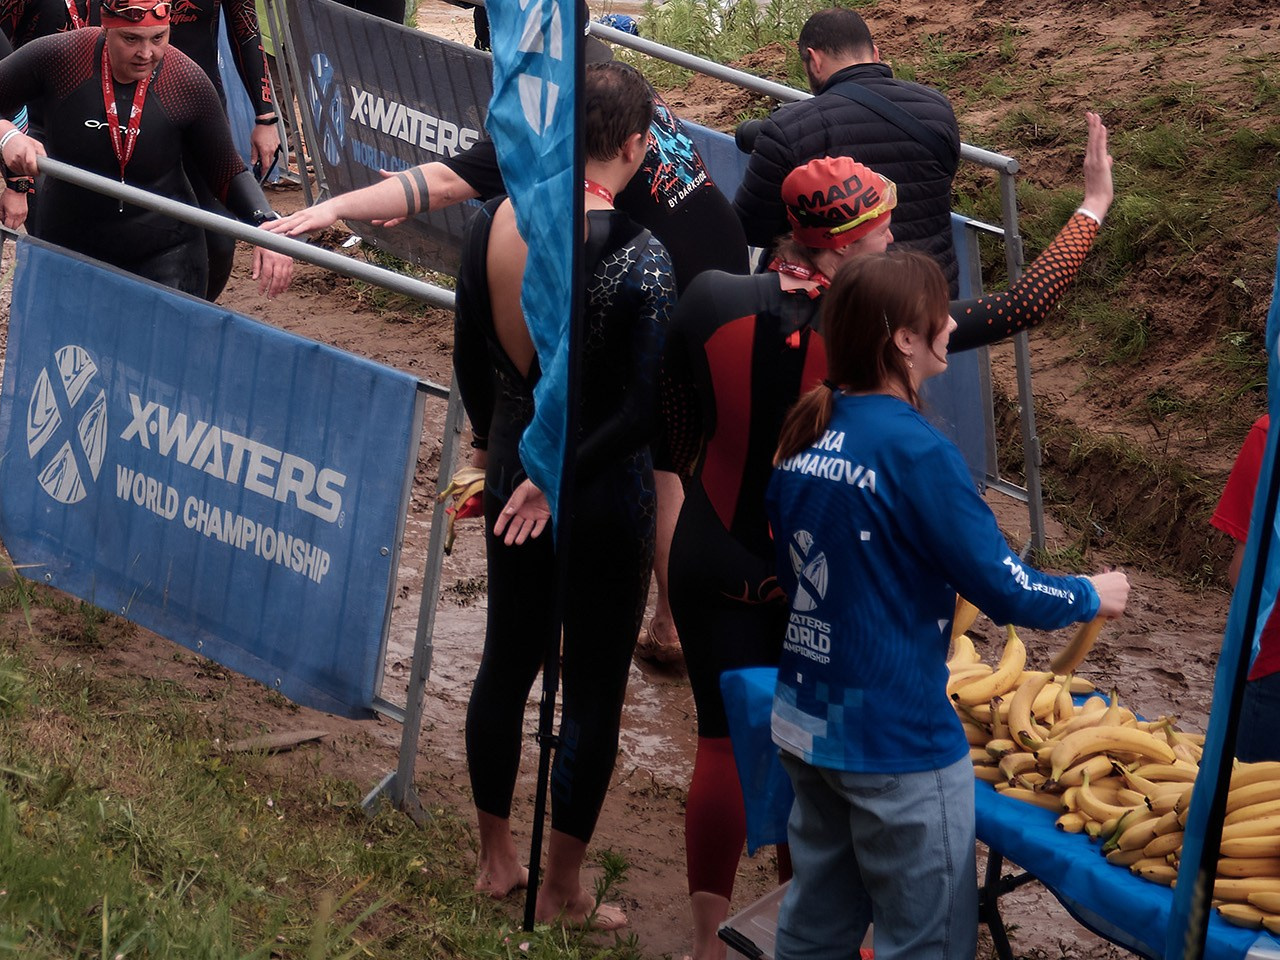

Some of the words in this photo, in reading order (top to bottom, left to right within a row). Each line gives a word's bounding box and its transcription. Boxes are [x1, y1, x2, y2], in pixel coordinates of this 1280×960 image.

[351, 138, 386, 172] WORLD
[667, 195, 678, 208] BY
[678, 171, 707, 200] DARKSIDE
[797, 174, 863, 210] MAD
[811, 429, 846, 453] KA
[777, 453, 876, 494] OMAKOVA
[116, 464, 179, 521] WORLD
[183, 496, 331, 584] CHAMPIONSHIP
[784, 622, 831, 655] ORLD
